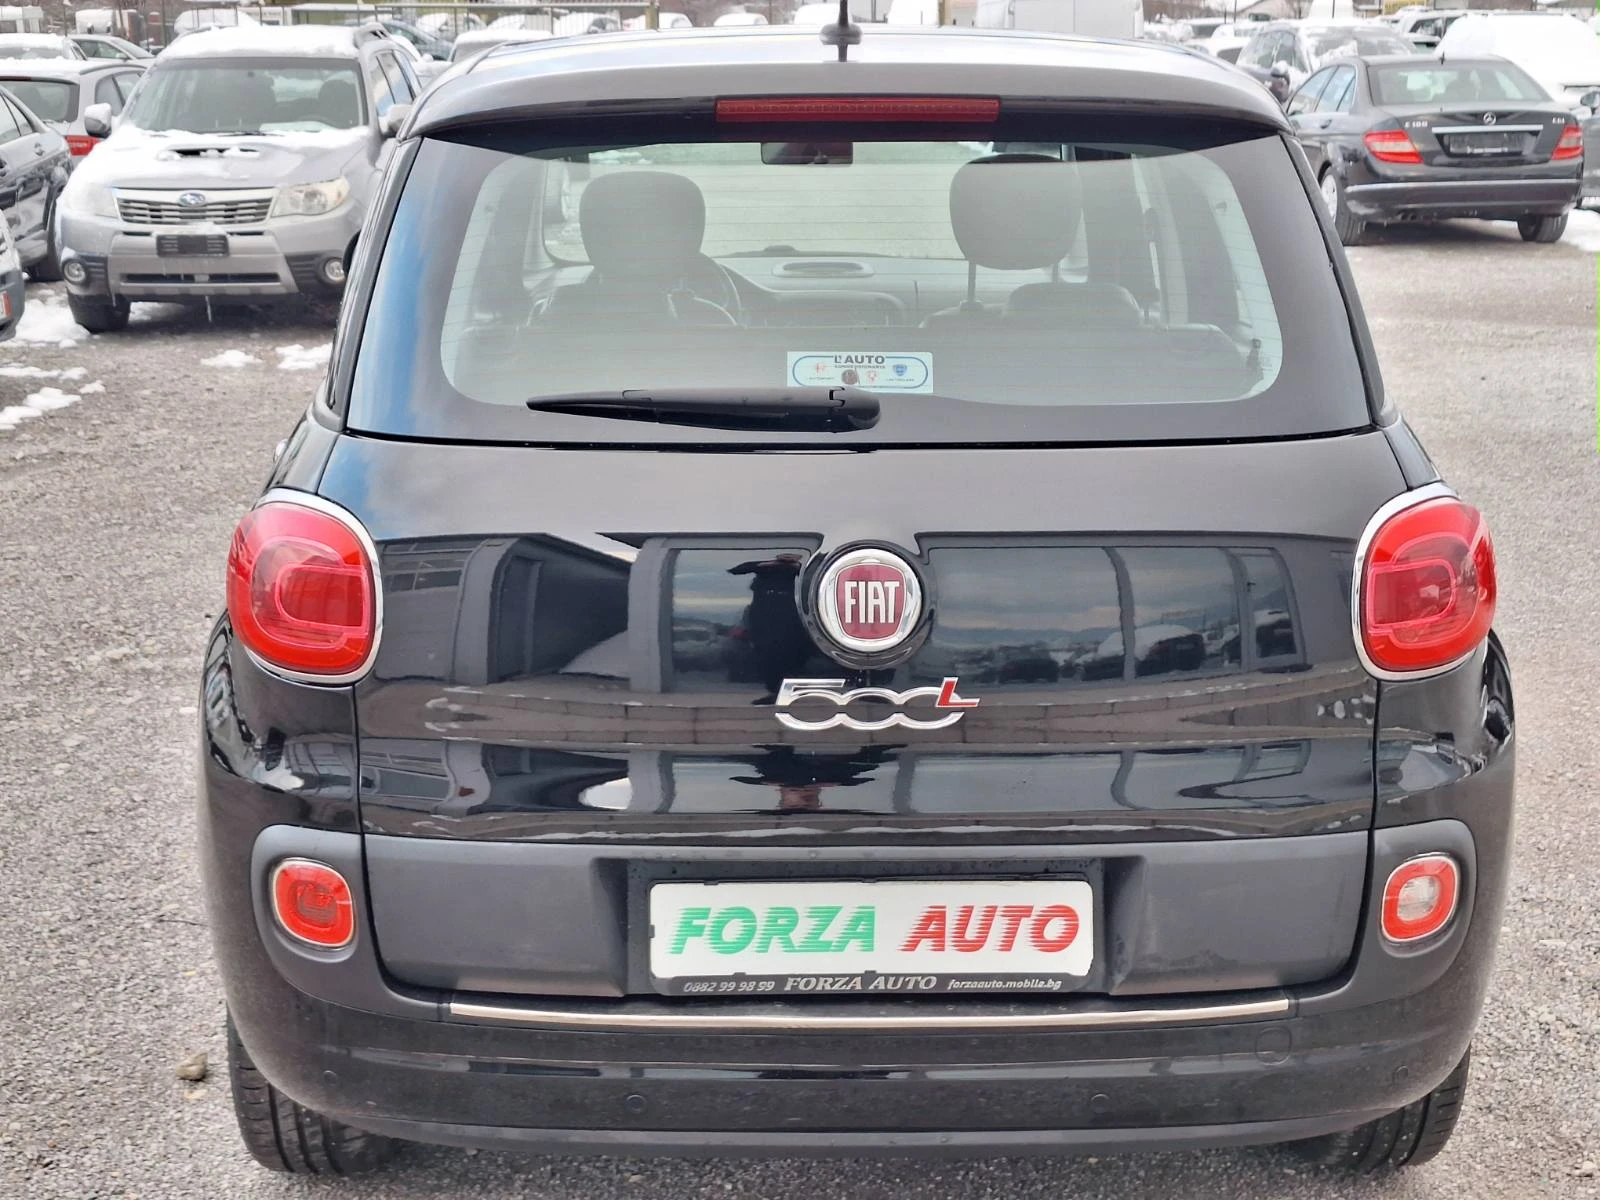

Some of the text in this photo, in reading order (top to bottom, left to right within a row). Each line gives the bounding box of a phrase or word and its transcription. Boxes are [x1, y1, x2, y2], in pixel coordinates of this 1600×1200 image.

[844, 580, 900, 624] FIAT
[775, 677, 980, 730] 500L
[666, 904, 1080, 955] FORZA AUTO
[683, 975, 1063, 992] 0882 99 98 99 FORZA AUTO forzaauto.mobile.bg
